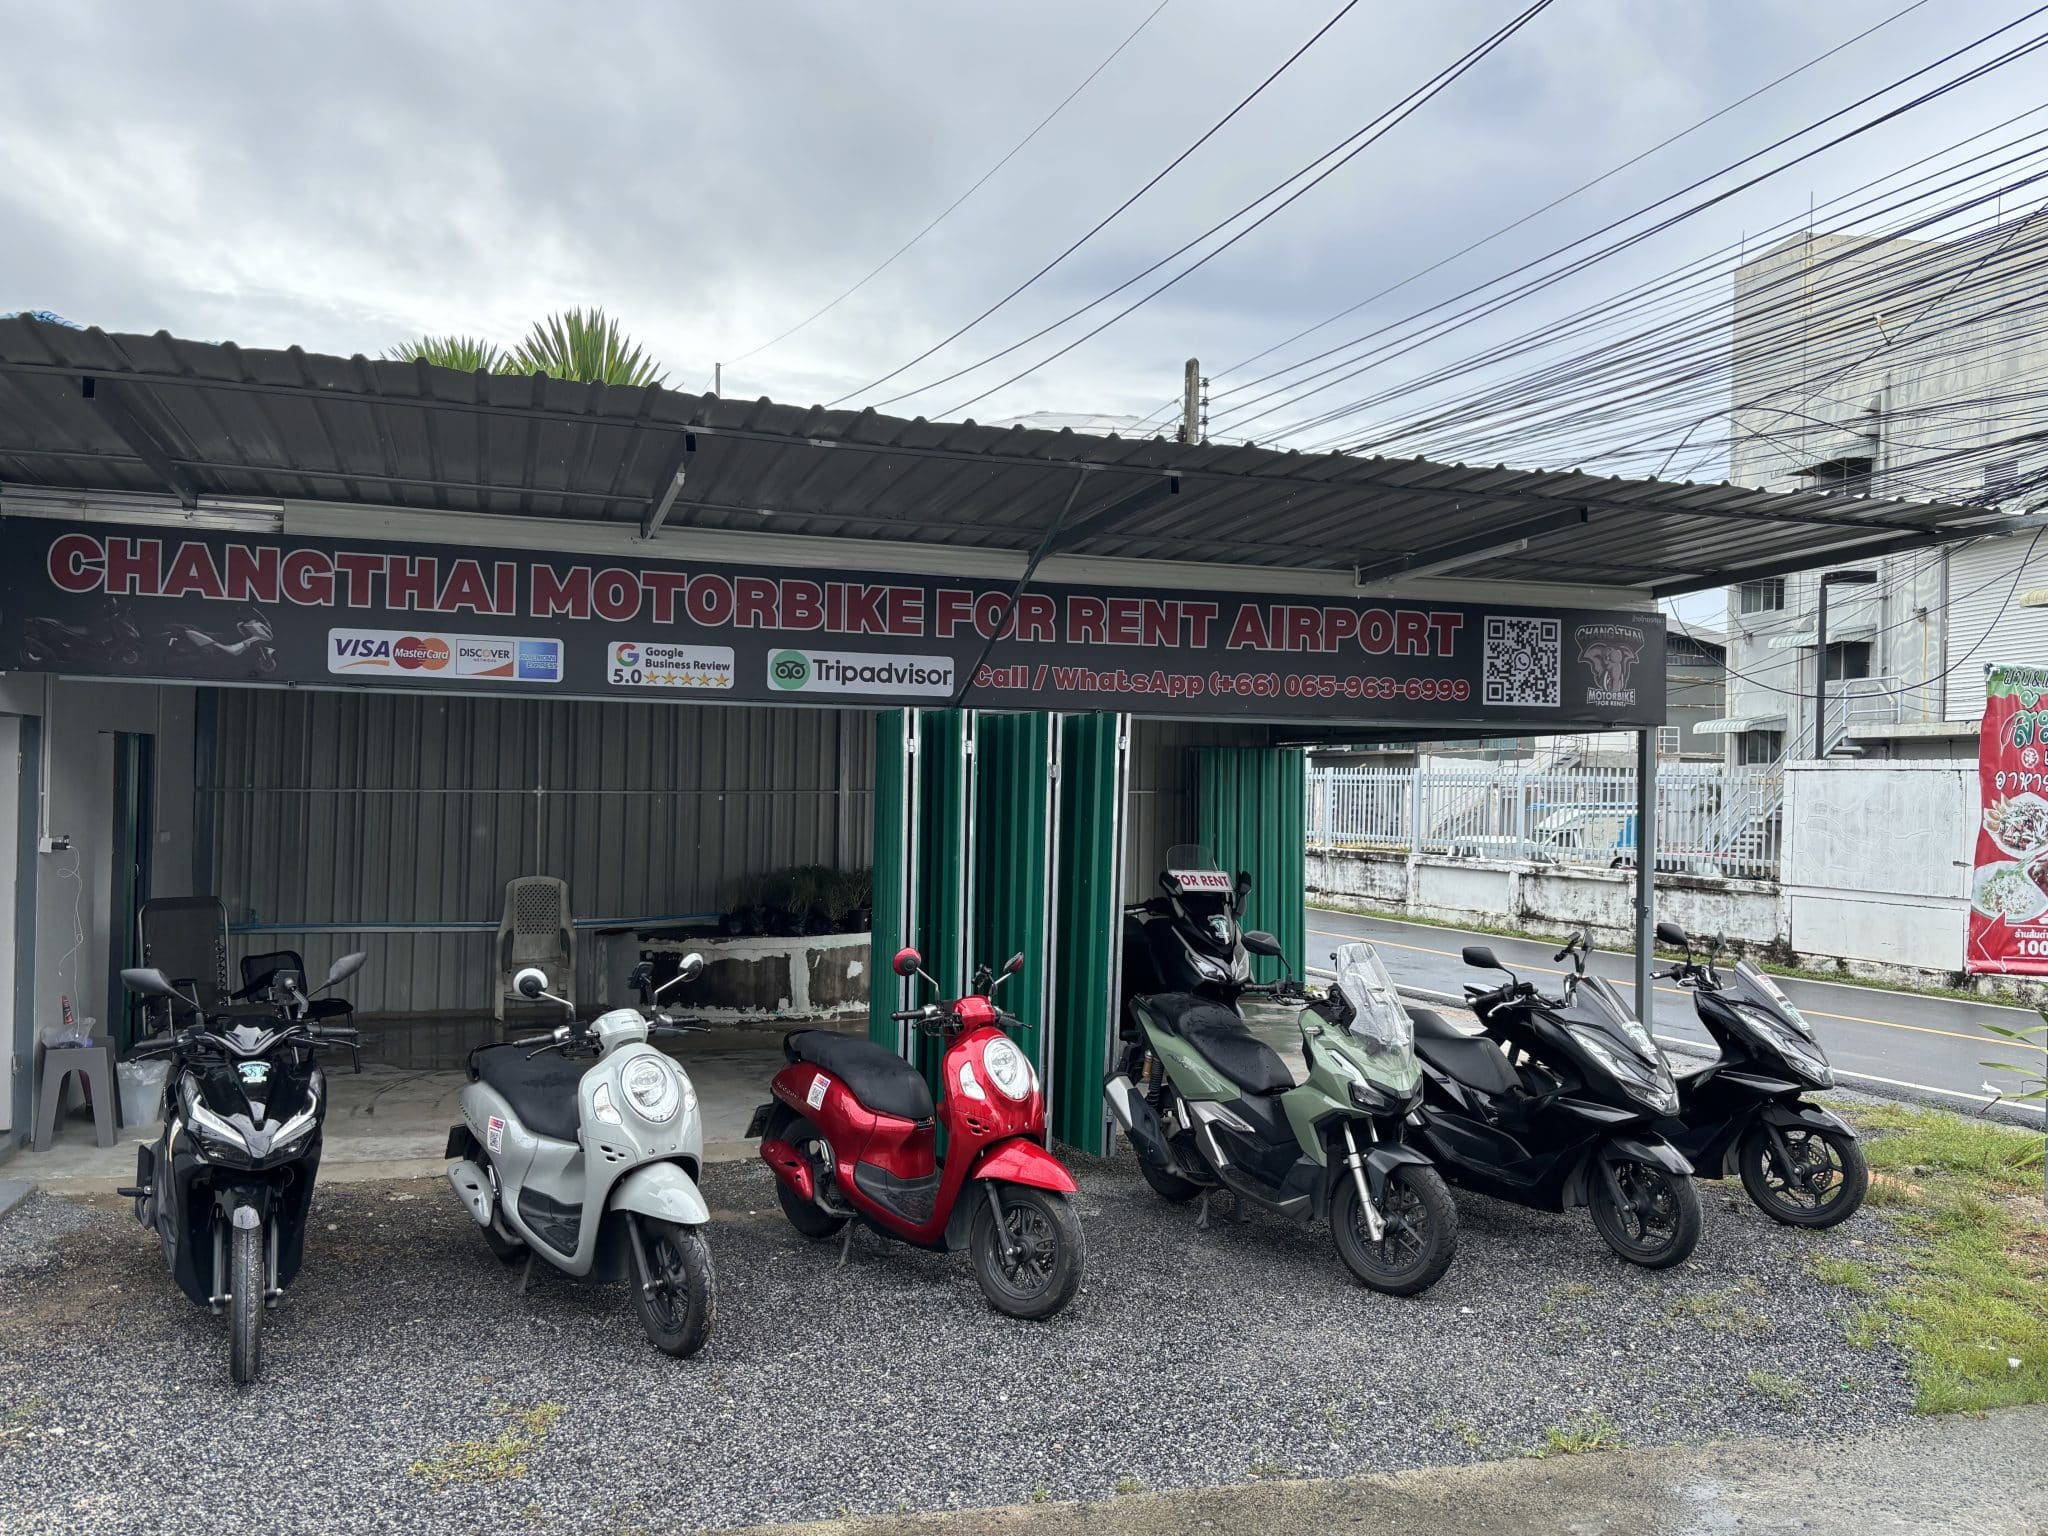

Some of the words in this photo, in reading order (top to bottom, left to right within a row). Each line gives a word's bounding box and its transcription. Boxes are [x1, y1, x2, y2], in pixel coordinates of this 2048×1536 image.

[48, 533, 517, 616] CHANGTHAI
[530, 563, 925, 637] MOTORBIKE
[935, 588, 1056, 642] FOR
[1066, 595, 1218, 649] RENT
[1226, 604, 1464, 658] AIRPORT
[334, 638, 390, 658] VISA
[393, 647, 449, 661] MasterCard
[459, 648, 511, 659] DISCOVER
[645, 647, 684, 659] Google
[645, 658, 691, 670] Business
[693, 661, 730, 671] Review
[612, 668, 642, 684] 5.0
[812, 659, 952, 686] Tripadvisor
[973, 663, 1028, 688] Call
[1052, 666, 1204, 698] WhatsApp
[1208, 670, 1281, 698] (+66)
[1284, 674, 1471, 701] 065-963-6999
[1588, 689, 1634, 703] MOTORBIKE
[1200, 875, 1229, 887] RENT
